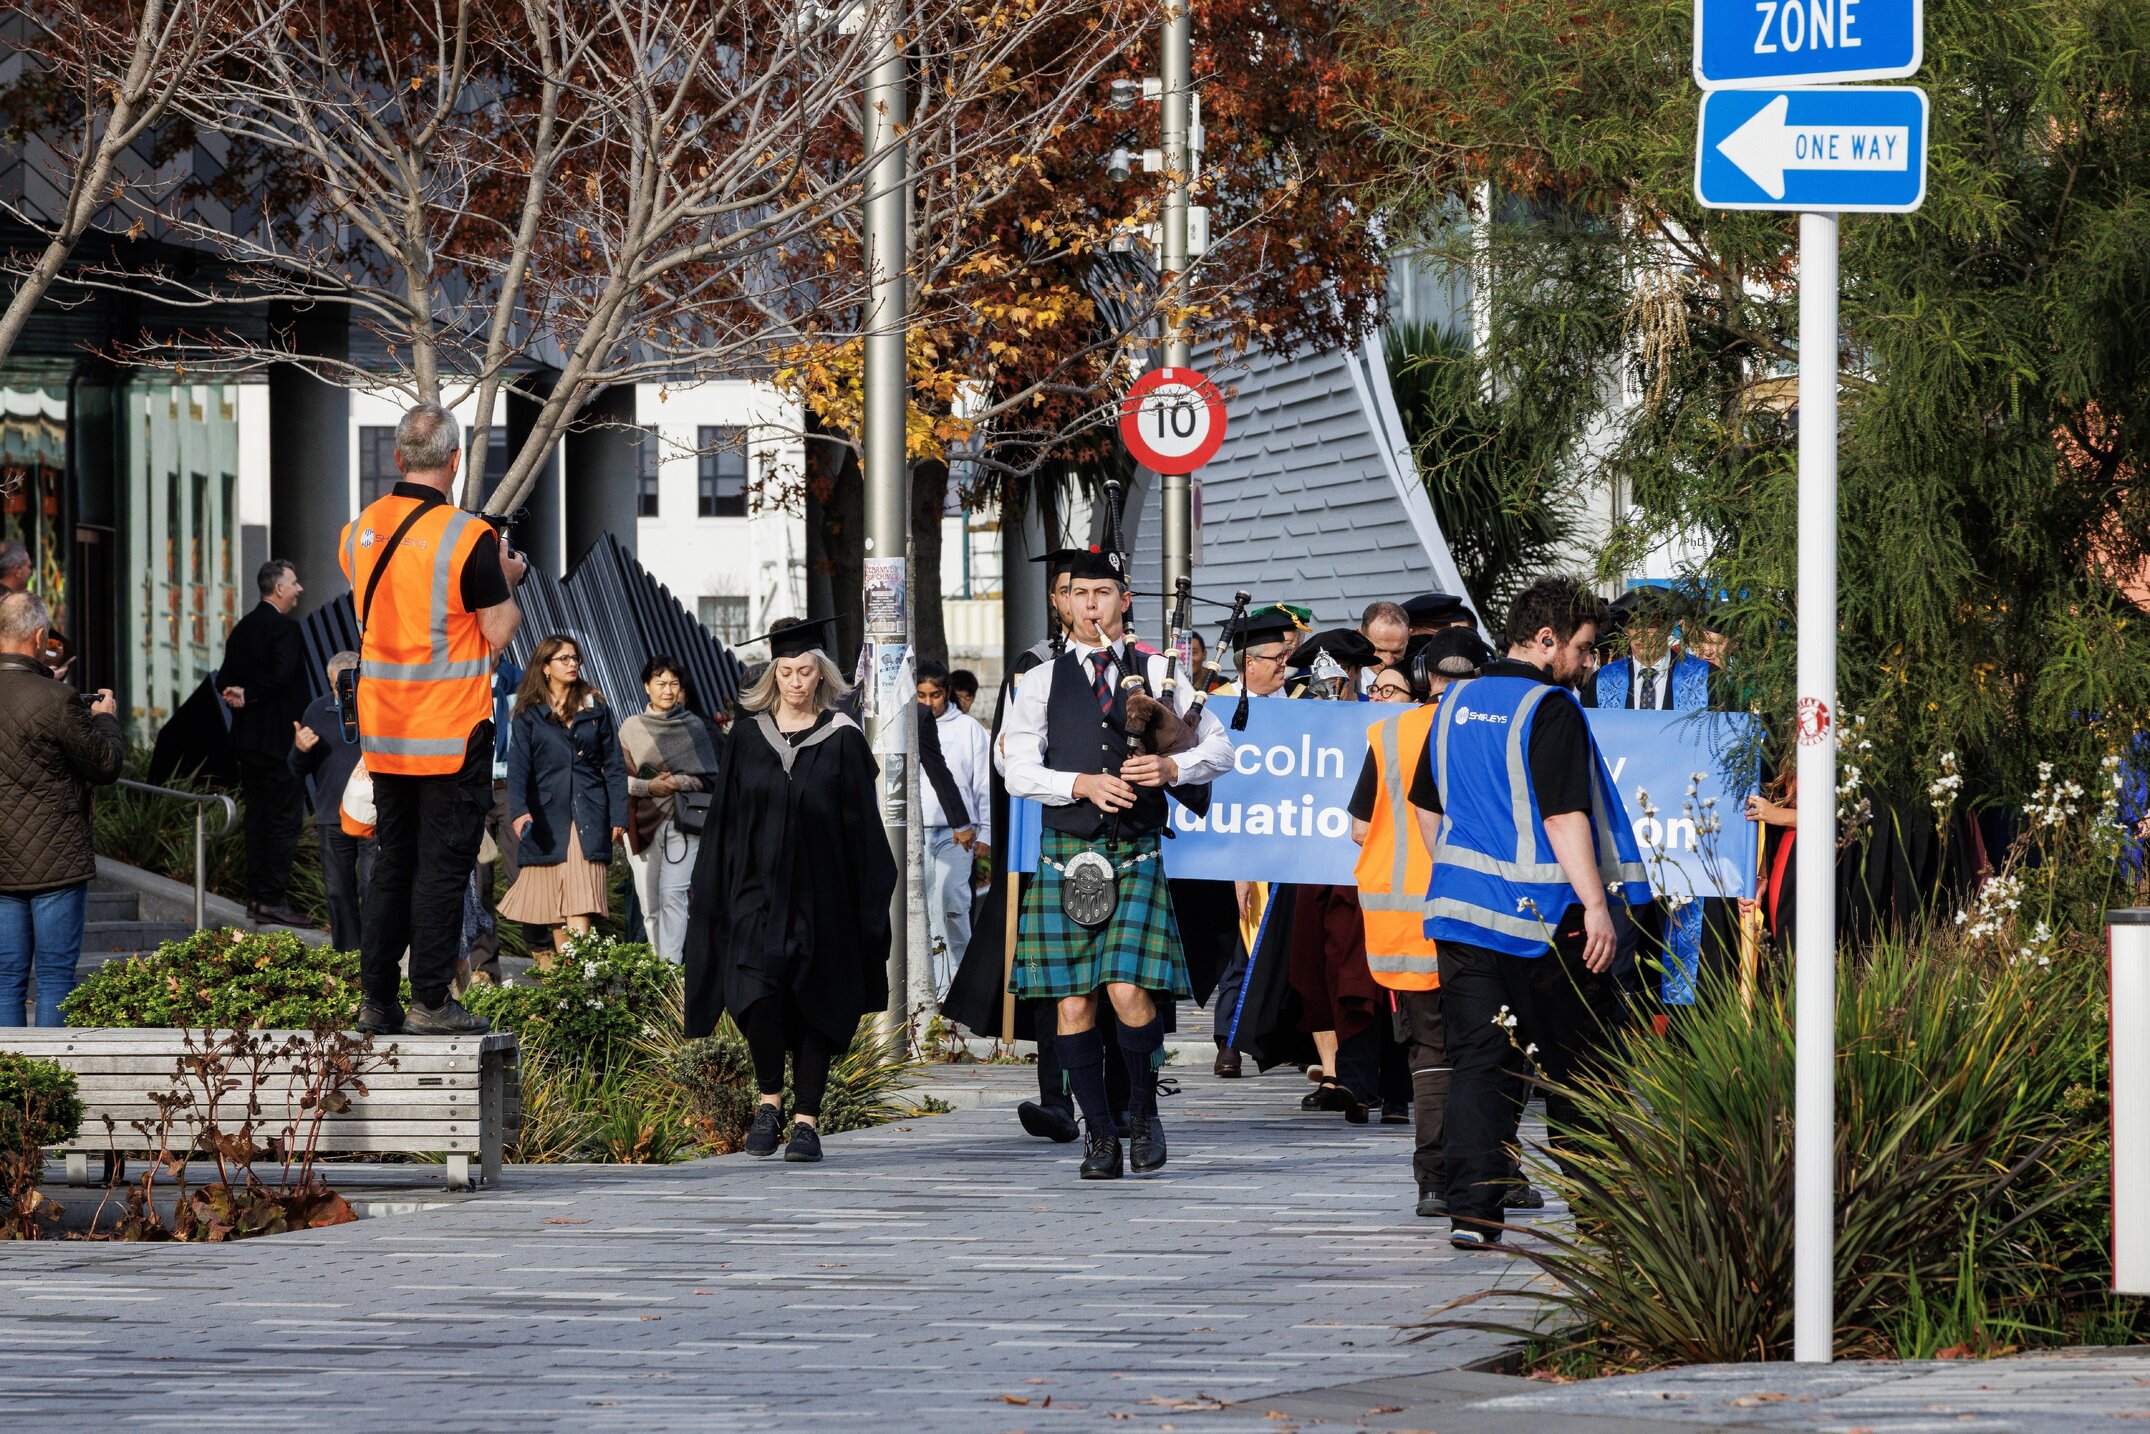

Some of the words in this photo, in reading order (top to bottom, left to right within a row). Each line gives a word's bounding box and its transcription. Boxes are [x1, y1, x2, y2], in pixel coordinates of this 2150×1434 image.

[1753, 0, 1862, 54] ZONE
[1796, 134, 1839, 160] ONE
[1851, 134, 1898, 161] WAY
[1155, 401, 1196, 438] 10
[1234, 734, 1344, 779] coln
[1168, 794, 1349, 838] duatio
